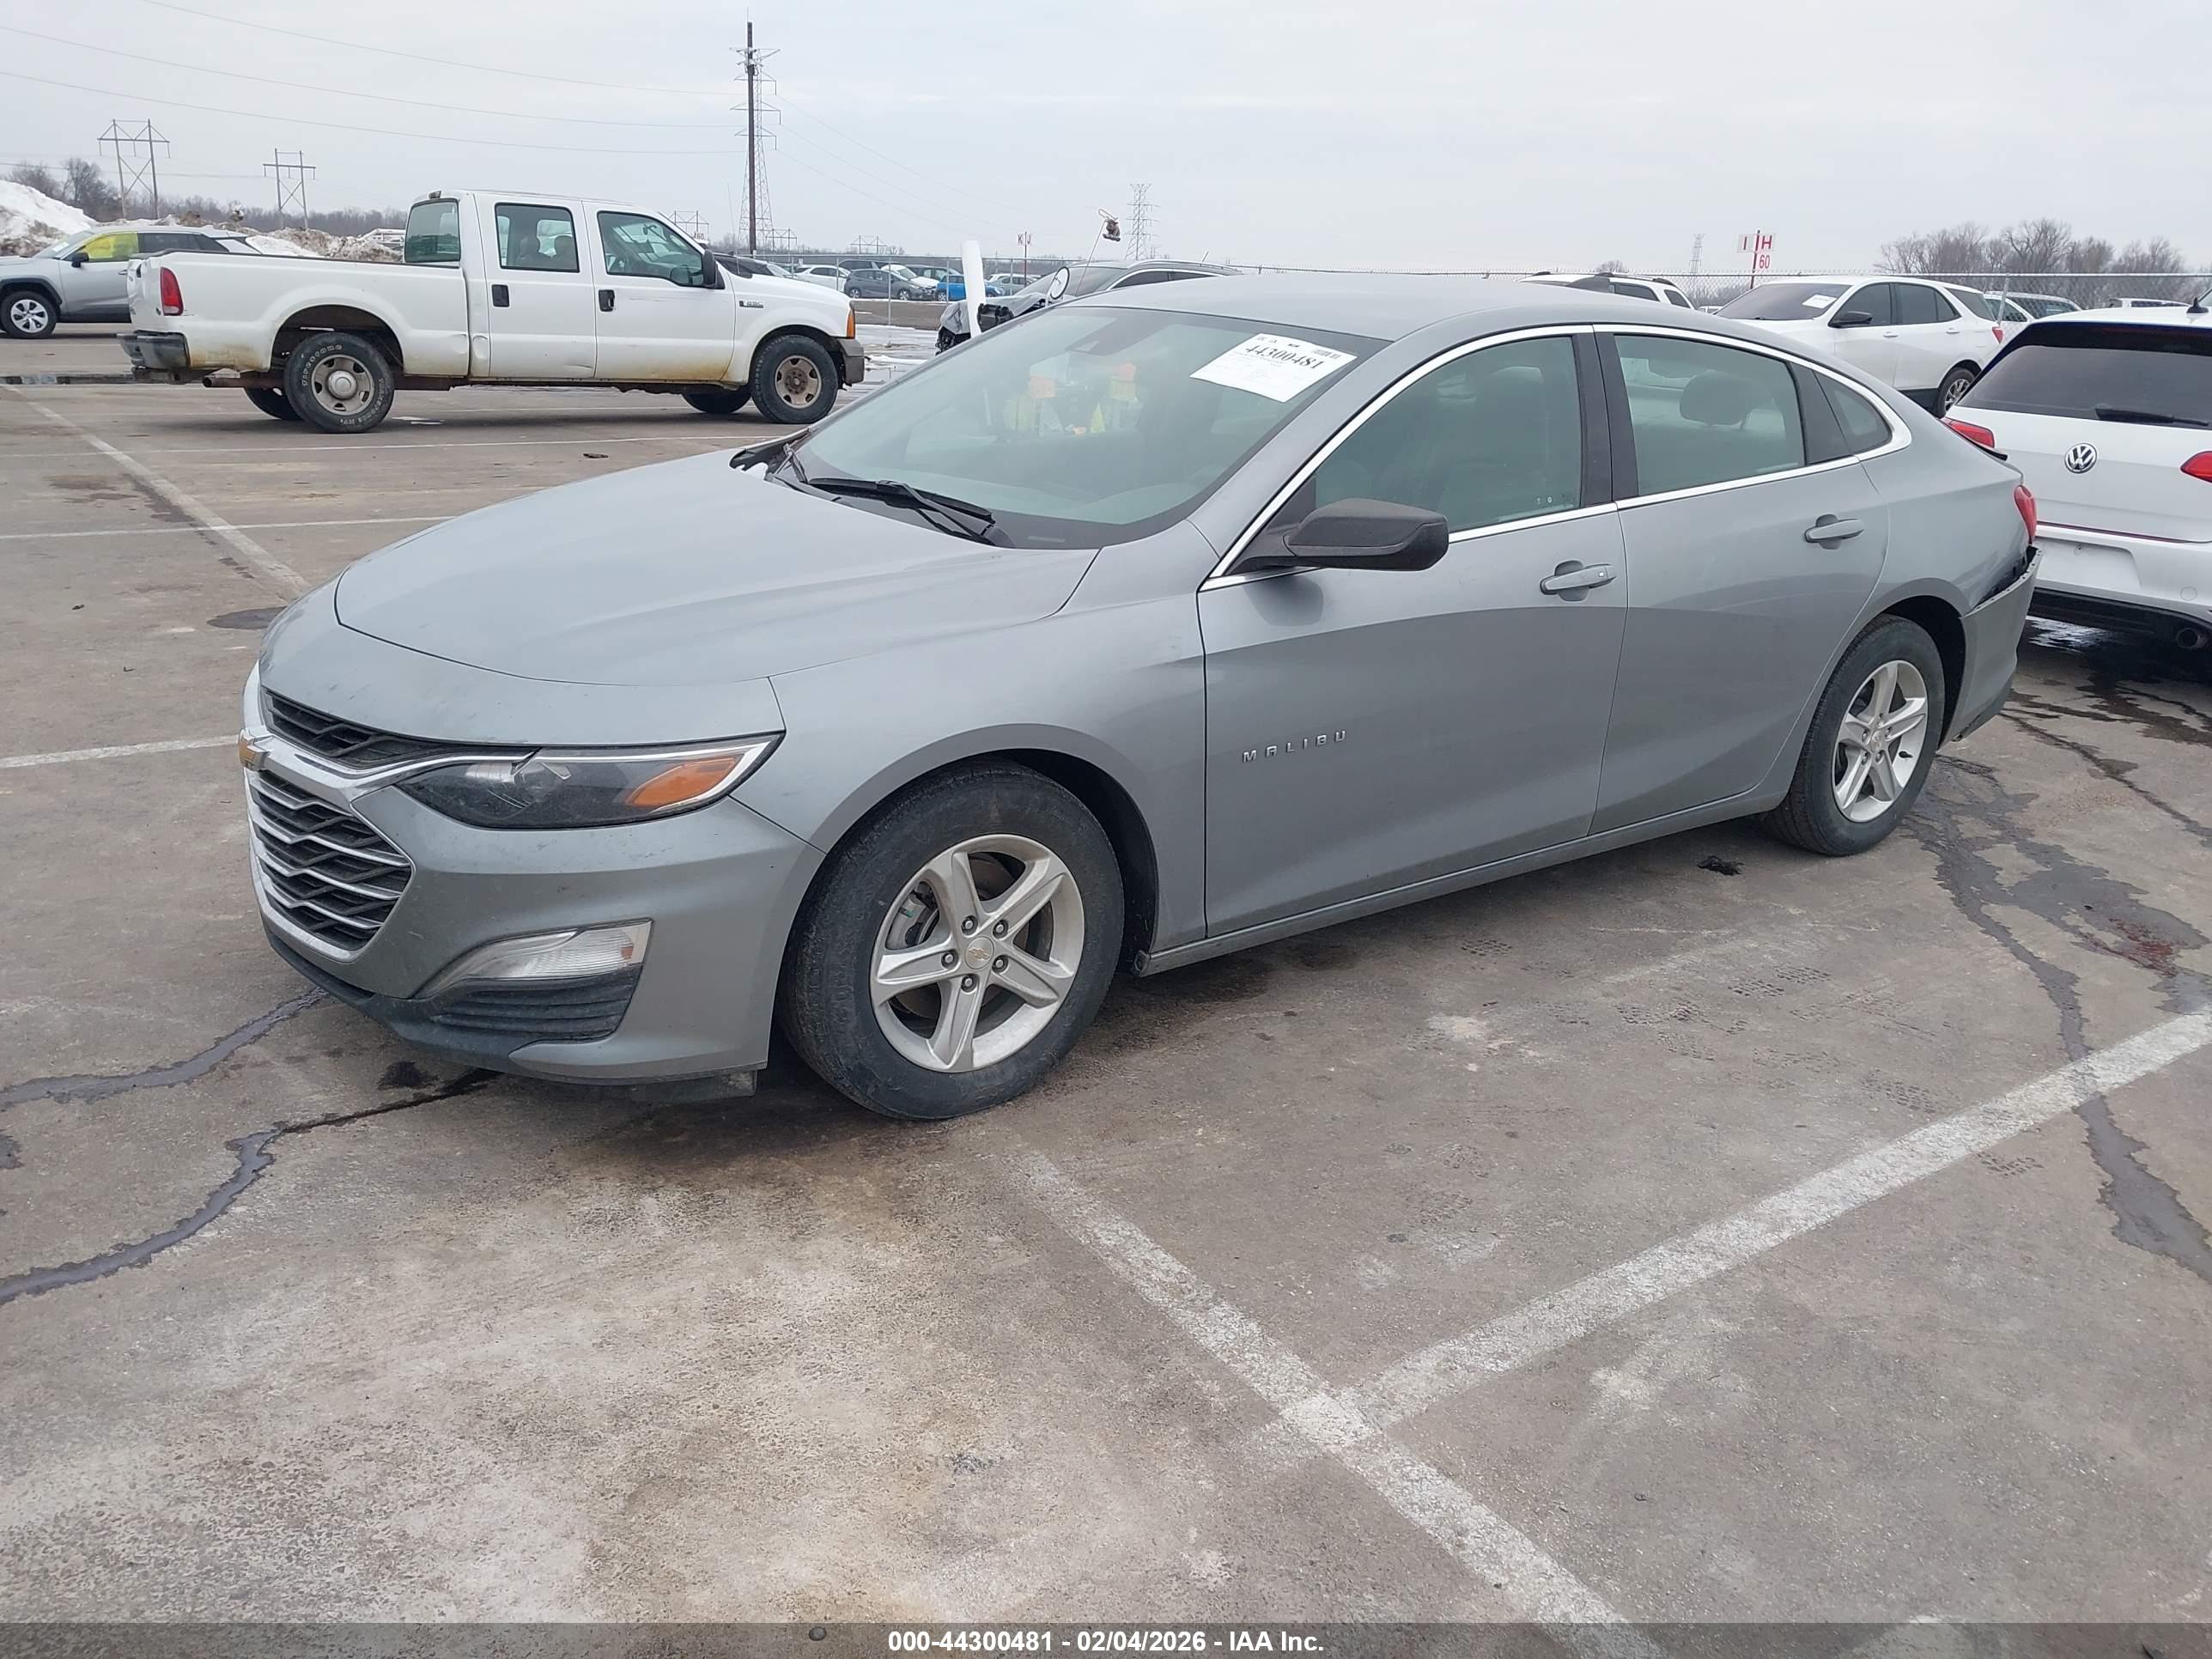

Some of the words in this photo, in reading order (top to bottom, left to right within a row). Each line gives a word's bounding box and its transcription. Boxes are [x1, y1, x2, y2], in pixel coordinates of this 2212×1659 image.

[1761, 235, 1772, 249] H
[1759, 254, 1771, 269] 60
[1245, 344, 1326, 369] 44300481
[1242, 730, 1346, 763] MALIBU
